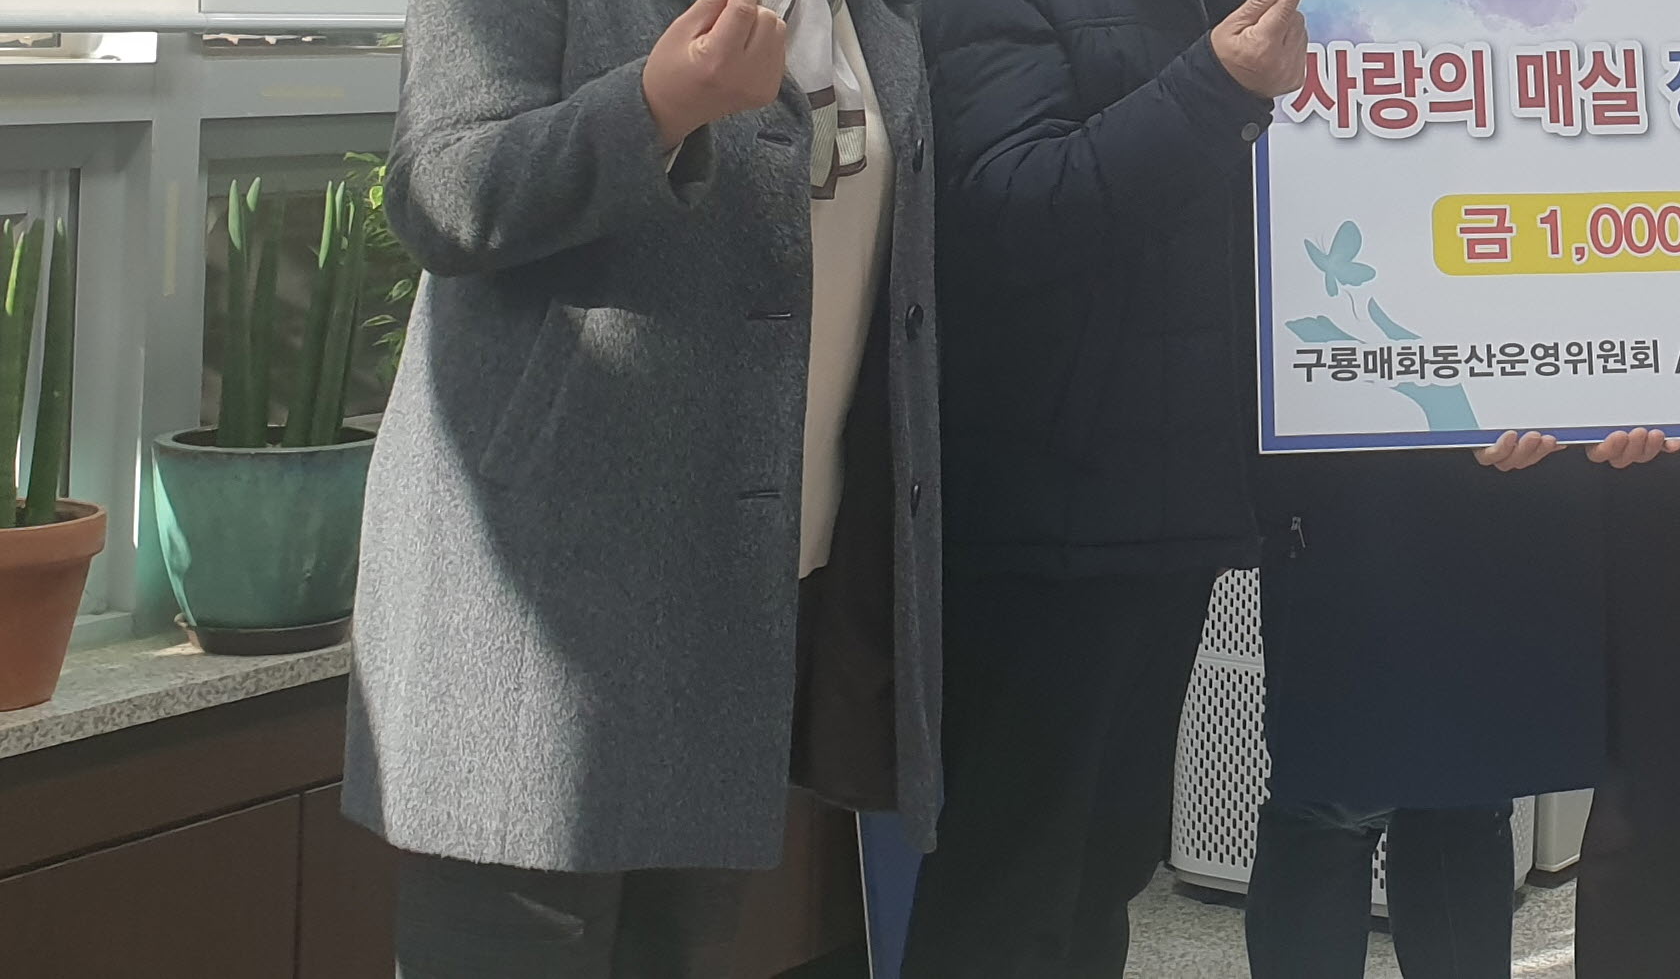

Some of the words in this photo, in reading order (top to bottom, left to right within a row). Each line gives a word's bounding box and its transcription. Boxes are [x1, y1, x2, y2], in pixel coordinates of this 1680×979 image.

[1291, 48, 1487, 130] 사랑의
[1516, 48, 1641, 127] 매실
[1459, 207, 1514, 260] 금
[1292, 338, 1661, 383] 구룡매화동산운영위원회
